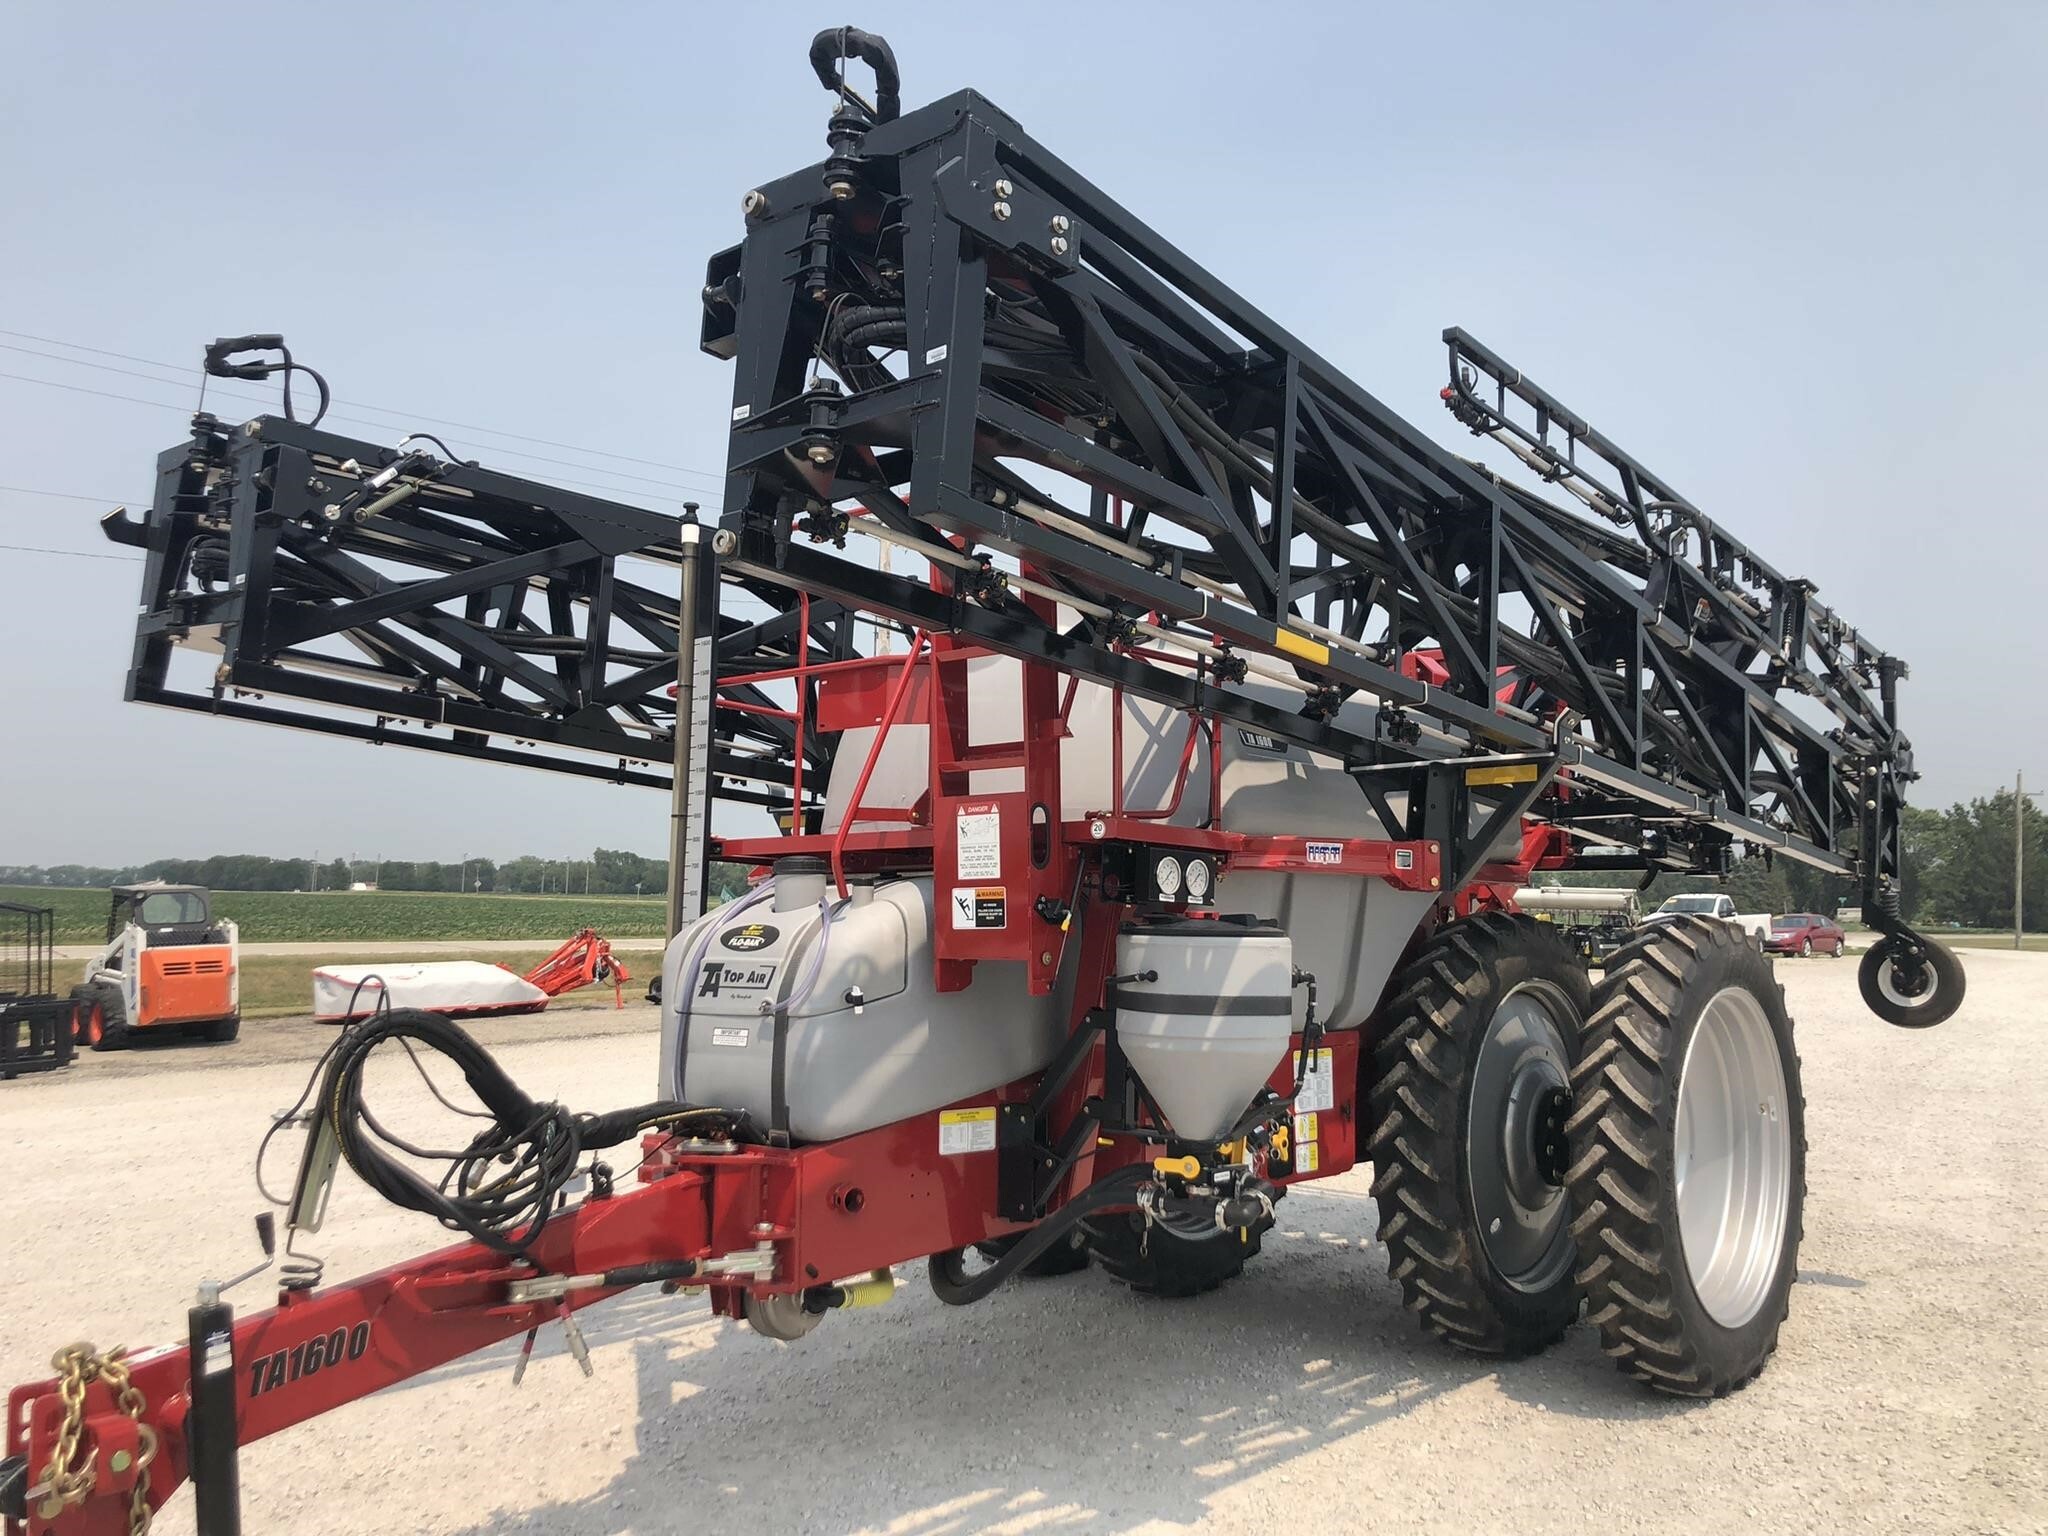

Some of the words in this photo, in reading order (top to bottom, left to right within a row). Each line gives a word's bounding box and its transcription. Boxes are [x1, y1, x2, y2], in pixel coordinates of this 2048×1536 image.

[967, 805, 989, 813] DANGER
[1093, 823, 1103, 832] 20
[724, 969, 745, 983] TOP
[746, 970, 767, 984] AIR
[250, 1319, 371, 1398] TA1600
